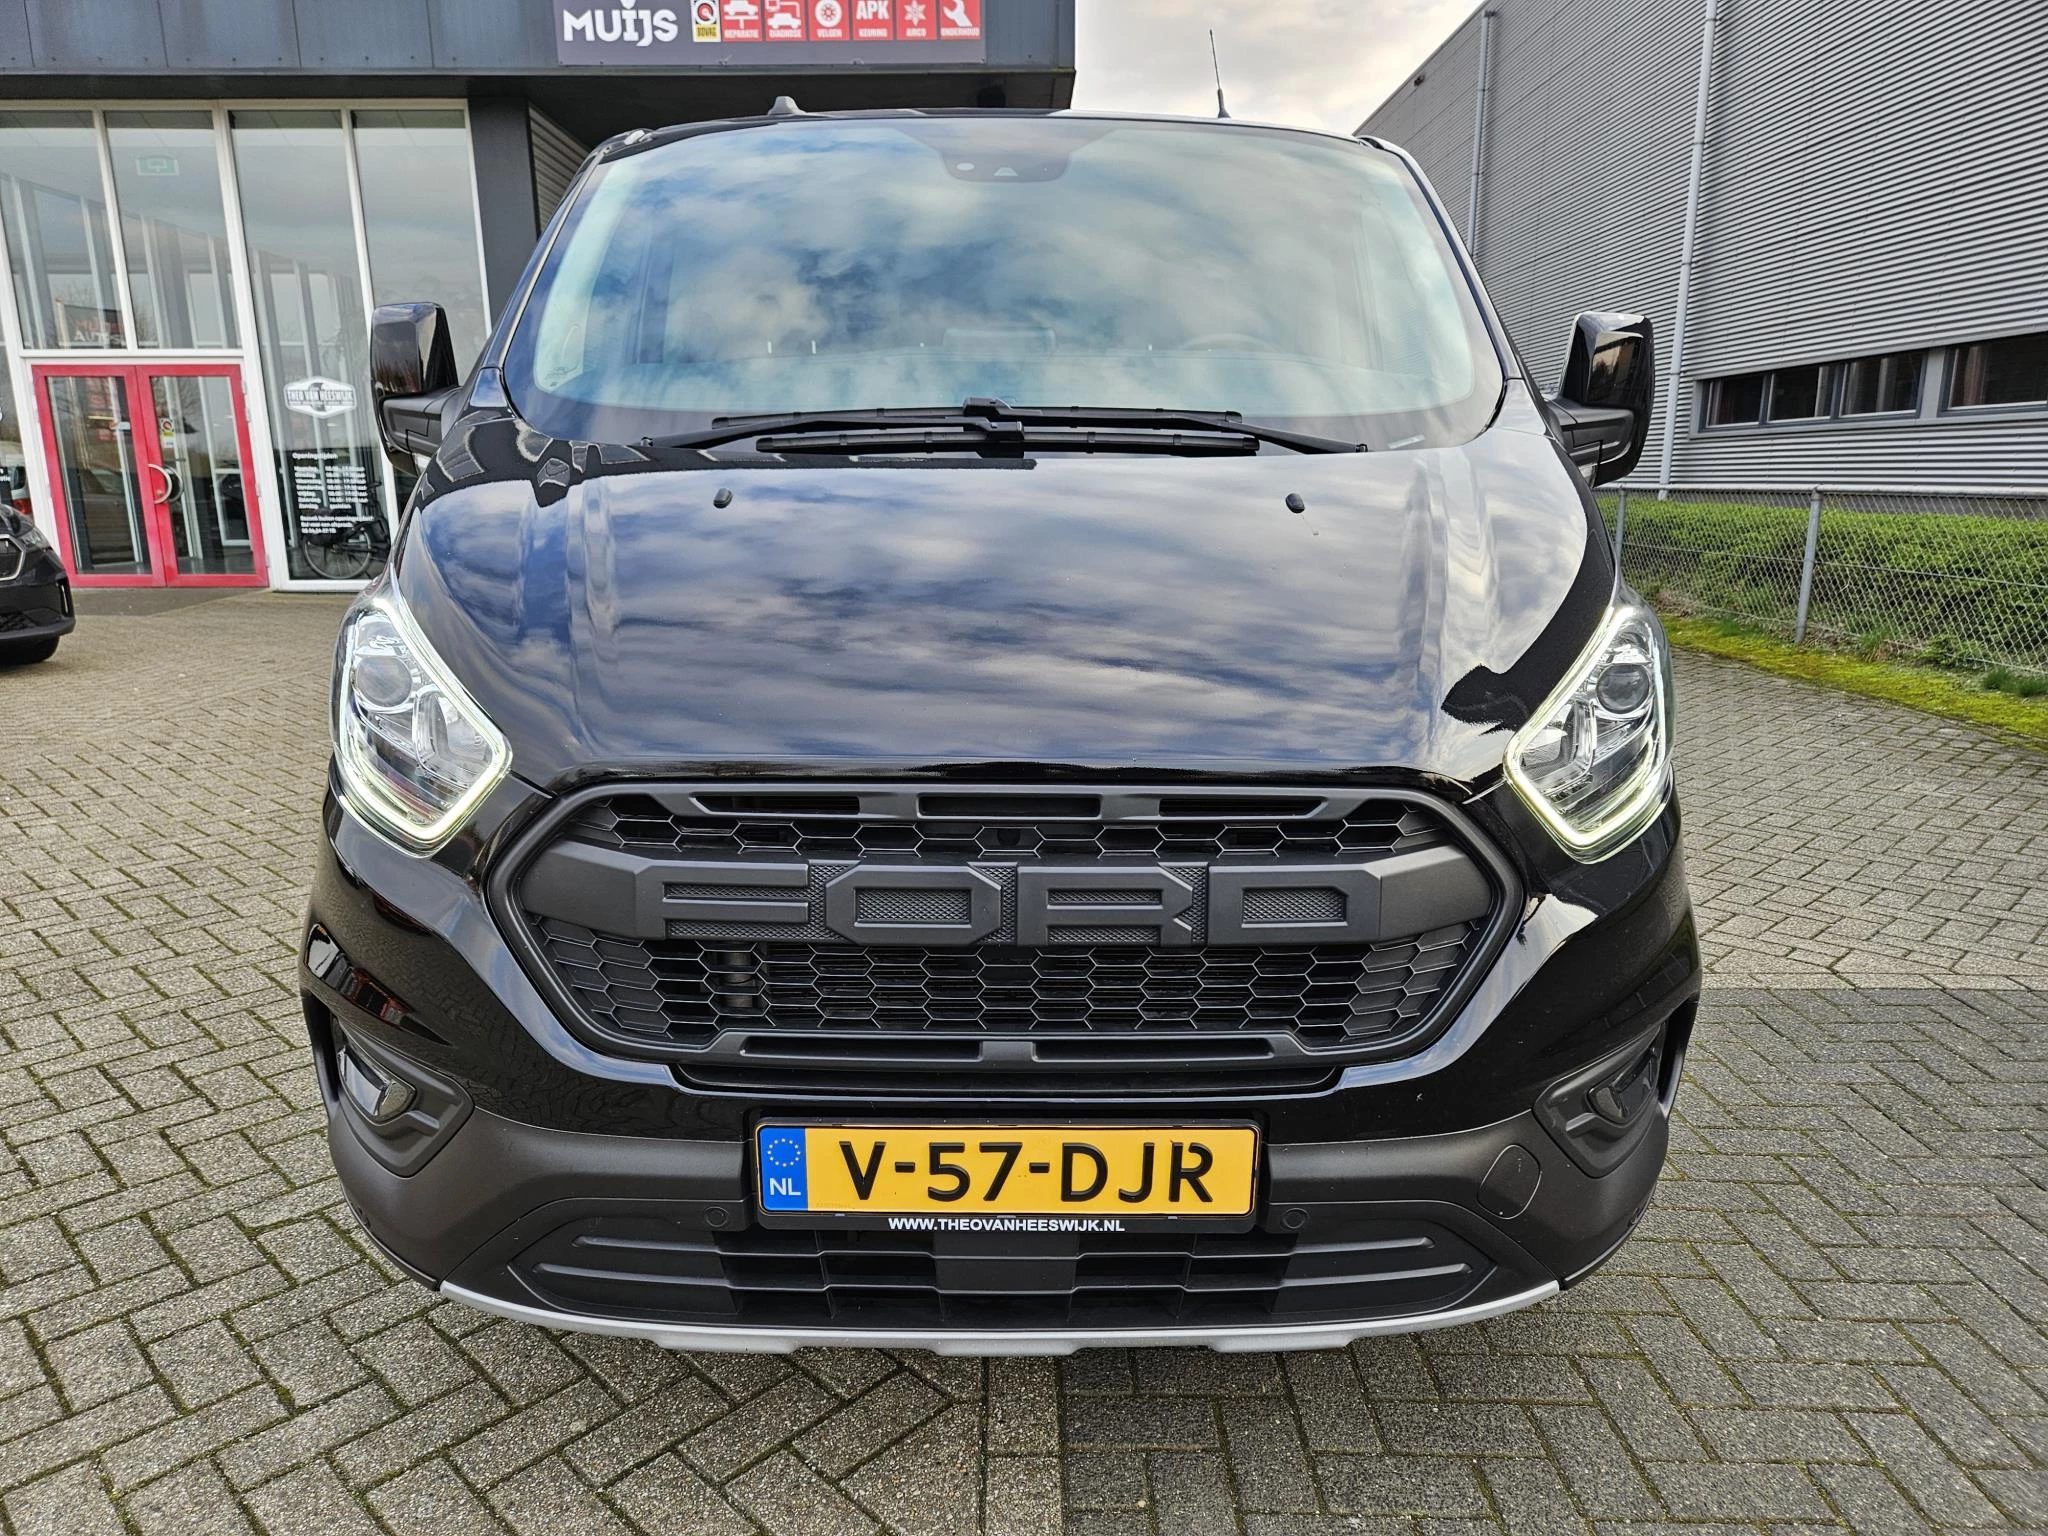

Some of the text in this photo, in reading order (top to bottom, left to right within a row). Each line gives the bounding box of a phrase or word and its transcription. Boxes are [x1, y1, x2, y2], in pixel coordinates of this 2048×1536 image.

[563, 1, 679, 47] MUIJS
[856, 0, 889, 20] APK
[635, 860, 1382, 944] FORD
[769, 1178, 801, 1196] NL
[839, 1141, 1214, 1203] V-57-DJR
[888, 1217, 1125, 1232] WWW.THEOVANHEESWIJK.NL
